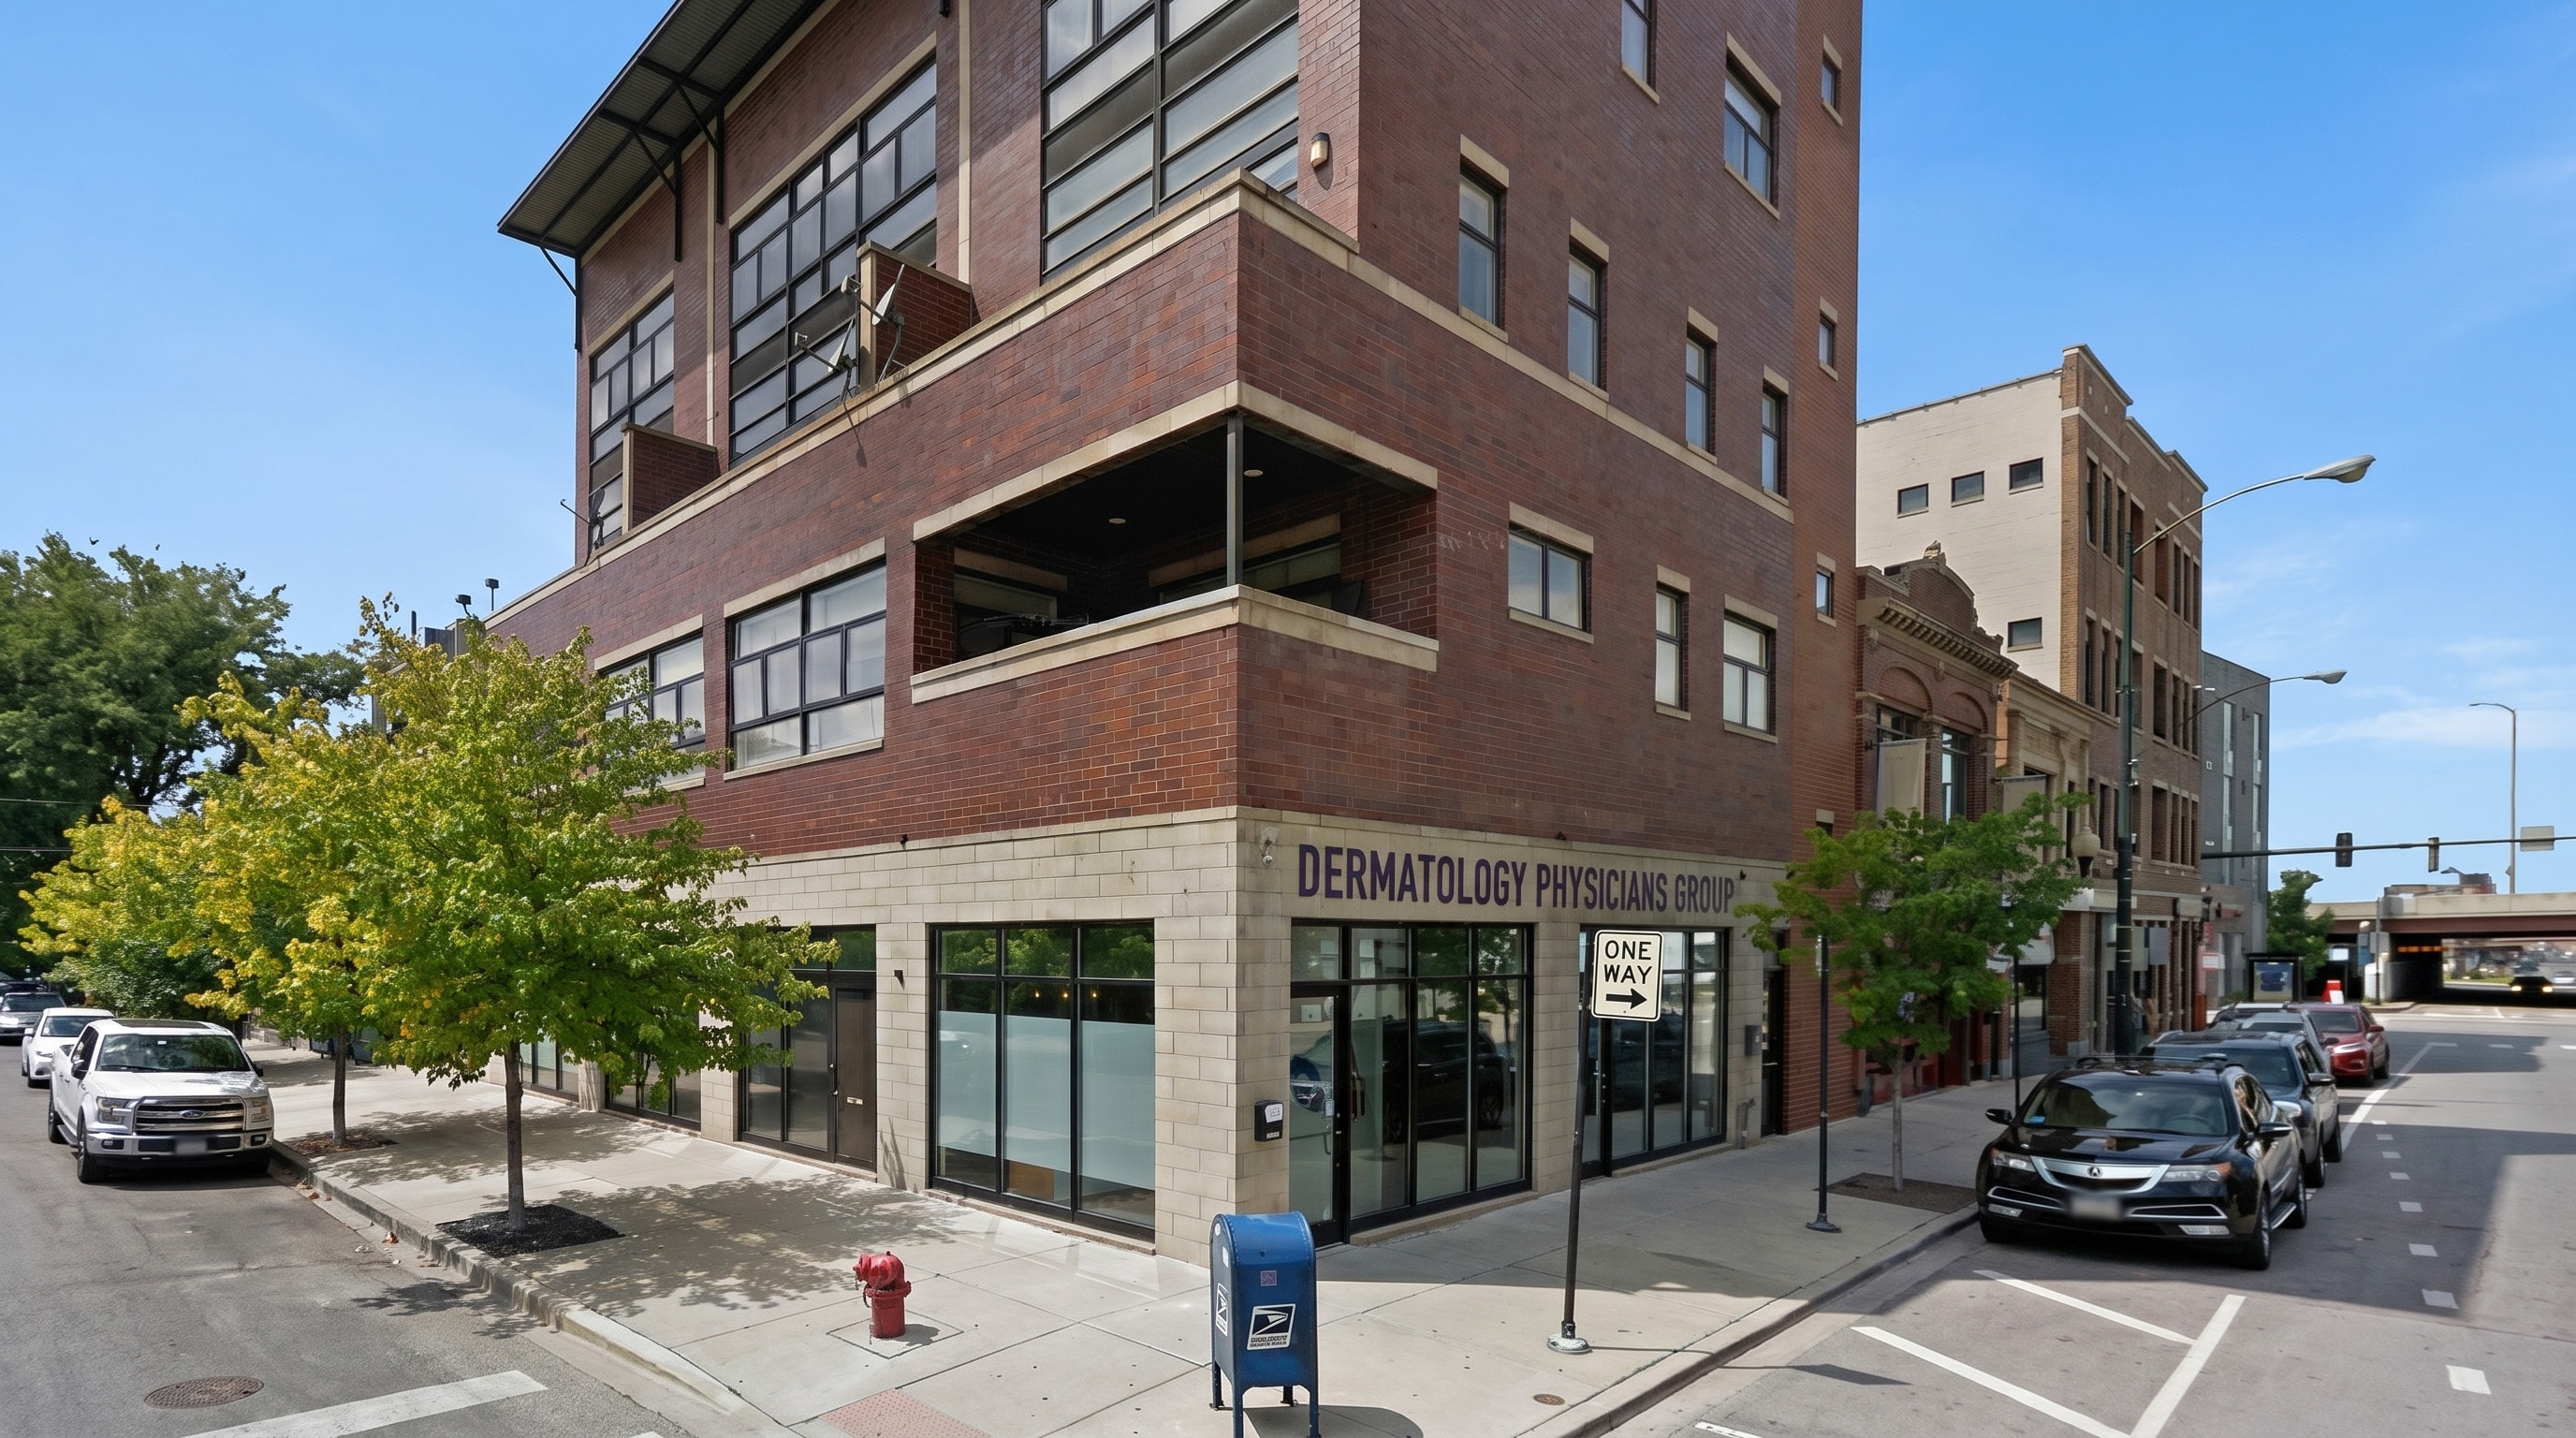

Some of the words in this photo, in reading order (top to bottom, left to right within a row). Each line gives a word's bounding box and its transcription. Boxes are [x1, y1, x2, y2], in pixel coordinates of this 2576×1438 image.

[1298, 844, 1528, 906] DERMATOLOGY
[1536, 863, 1668, 913] PHYSICIANS
[1675, 873, 1734, 914] GROUP
[1604, 939, 1652, 961] ONE
[1603, 963, 1653, 985] WAY
